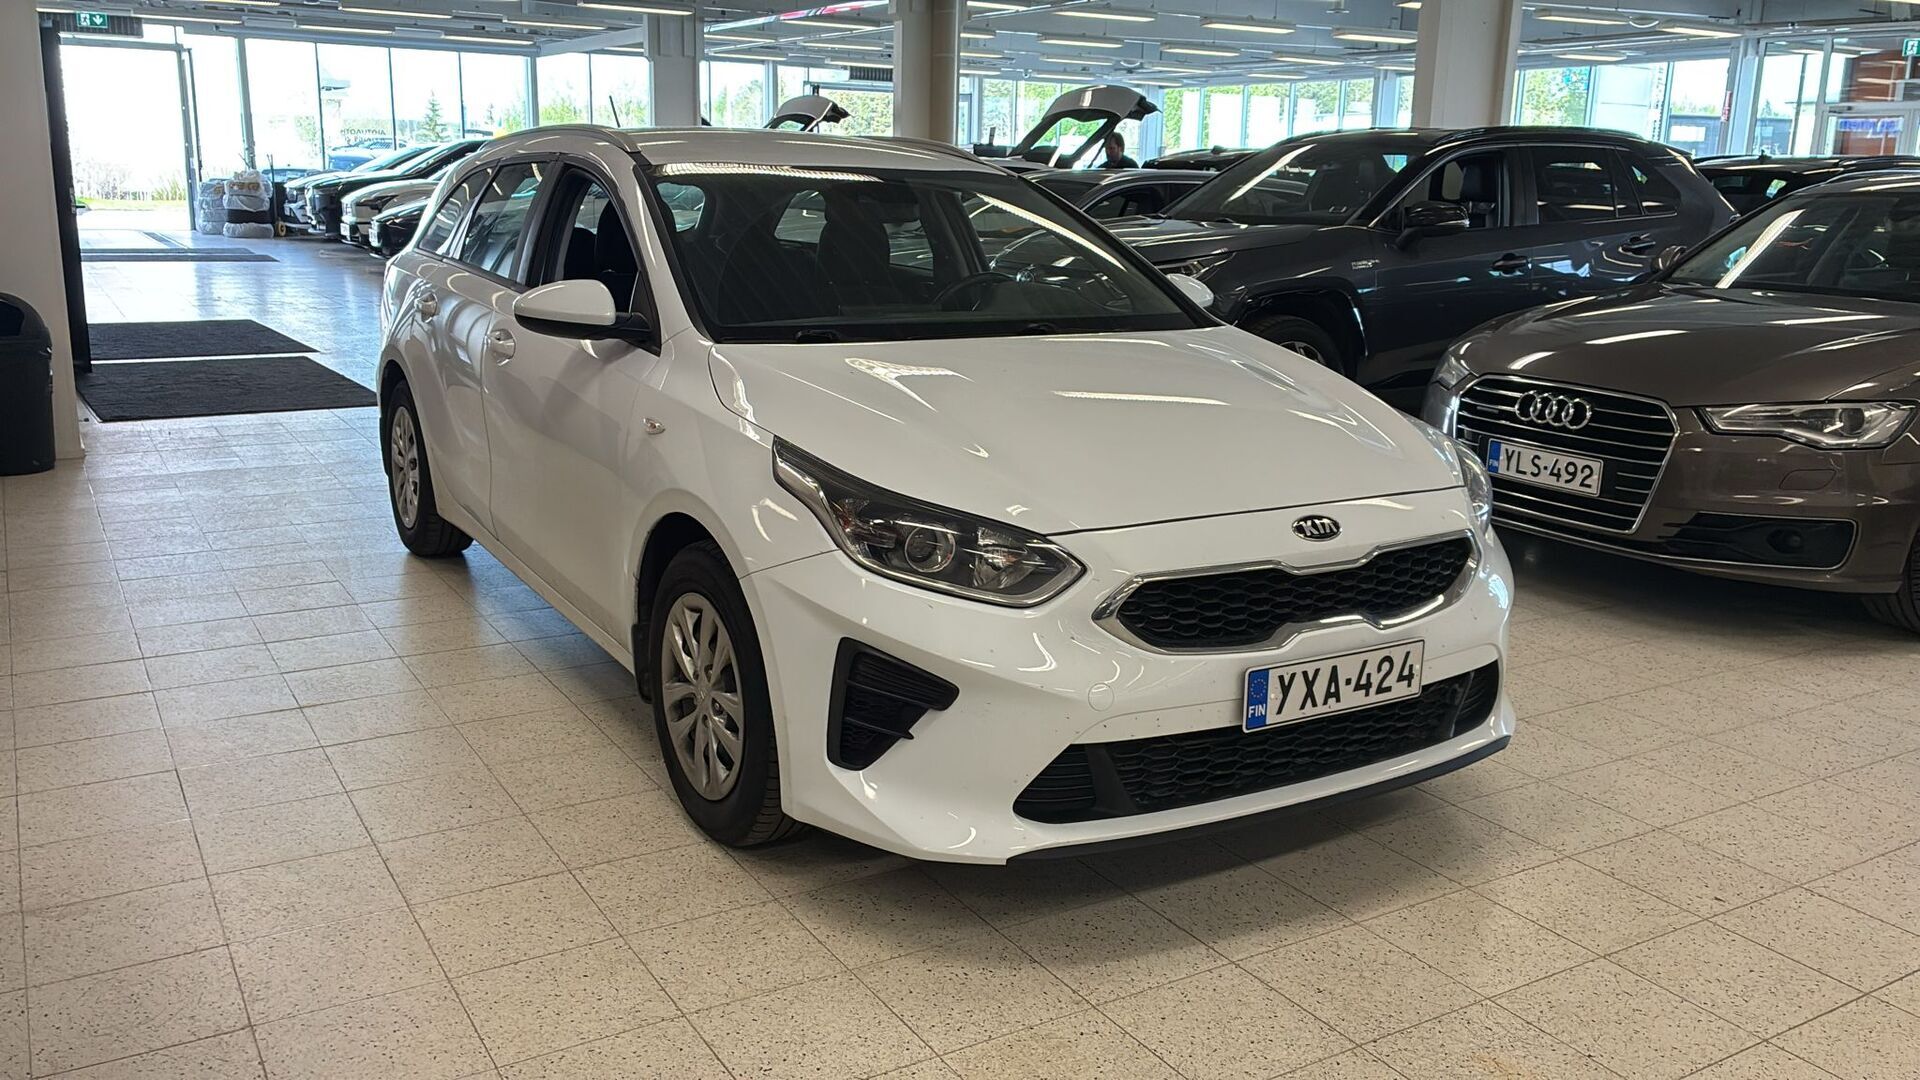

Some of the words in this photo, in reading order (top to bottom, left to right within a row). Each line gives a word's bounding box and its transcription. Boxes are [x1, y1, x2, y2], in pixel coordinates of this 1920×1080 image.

[1504, 447, 1595, 489] YLS-492
[1301, 518, 1338, 536] KIA
[1275, 650, 1415, 715] YXA-424
[1248, 704, 1267, 719] FIN
